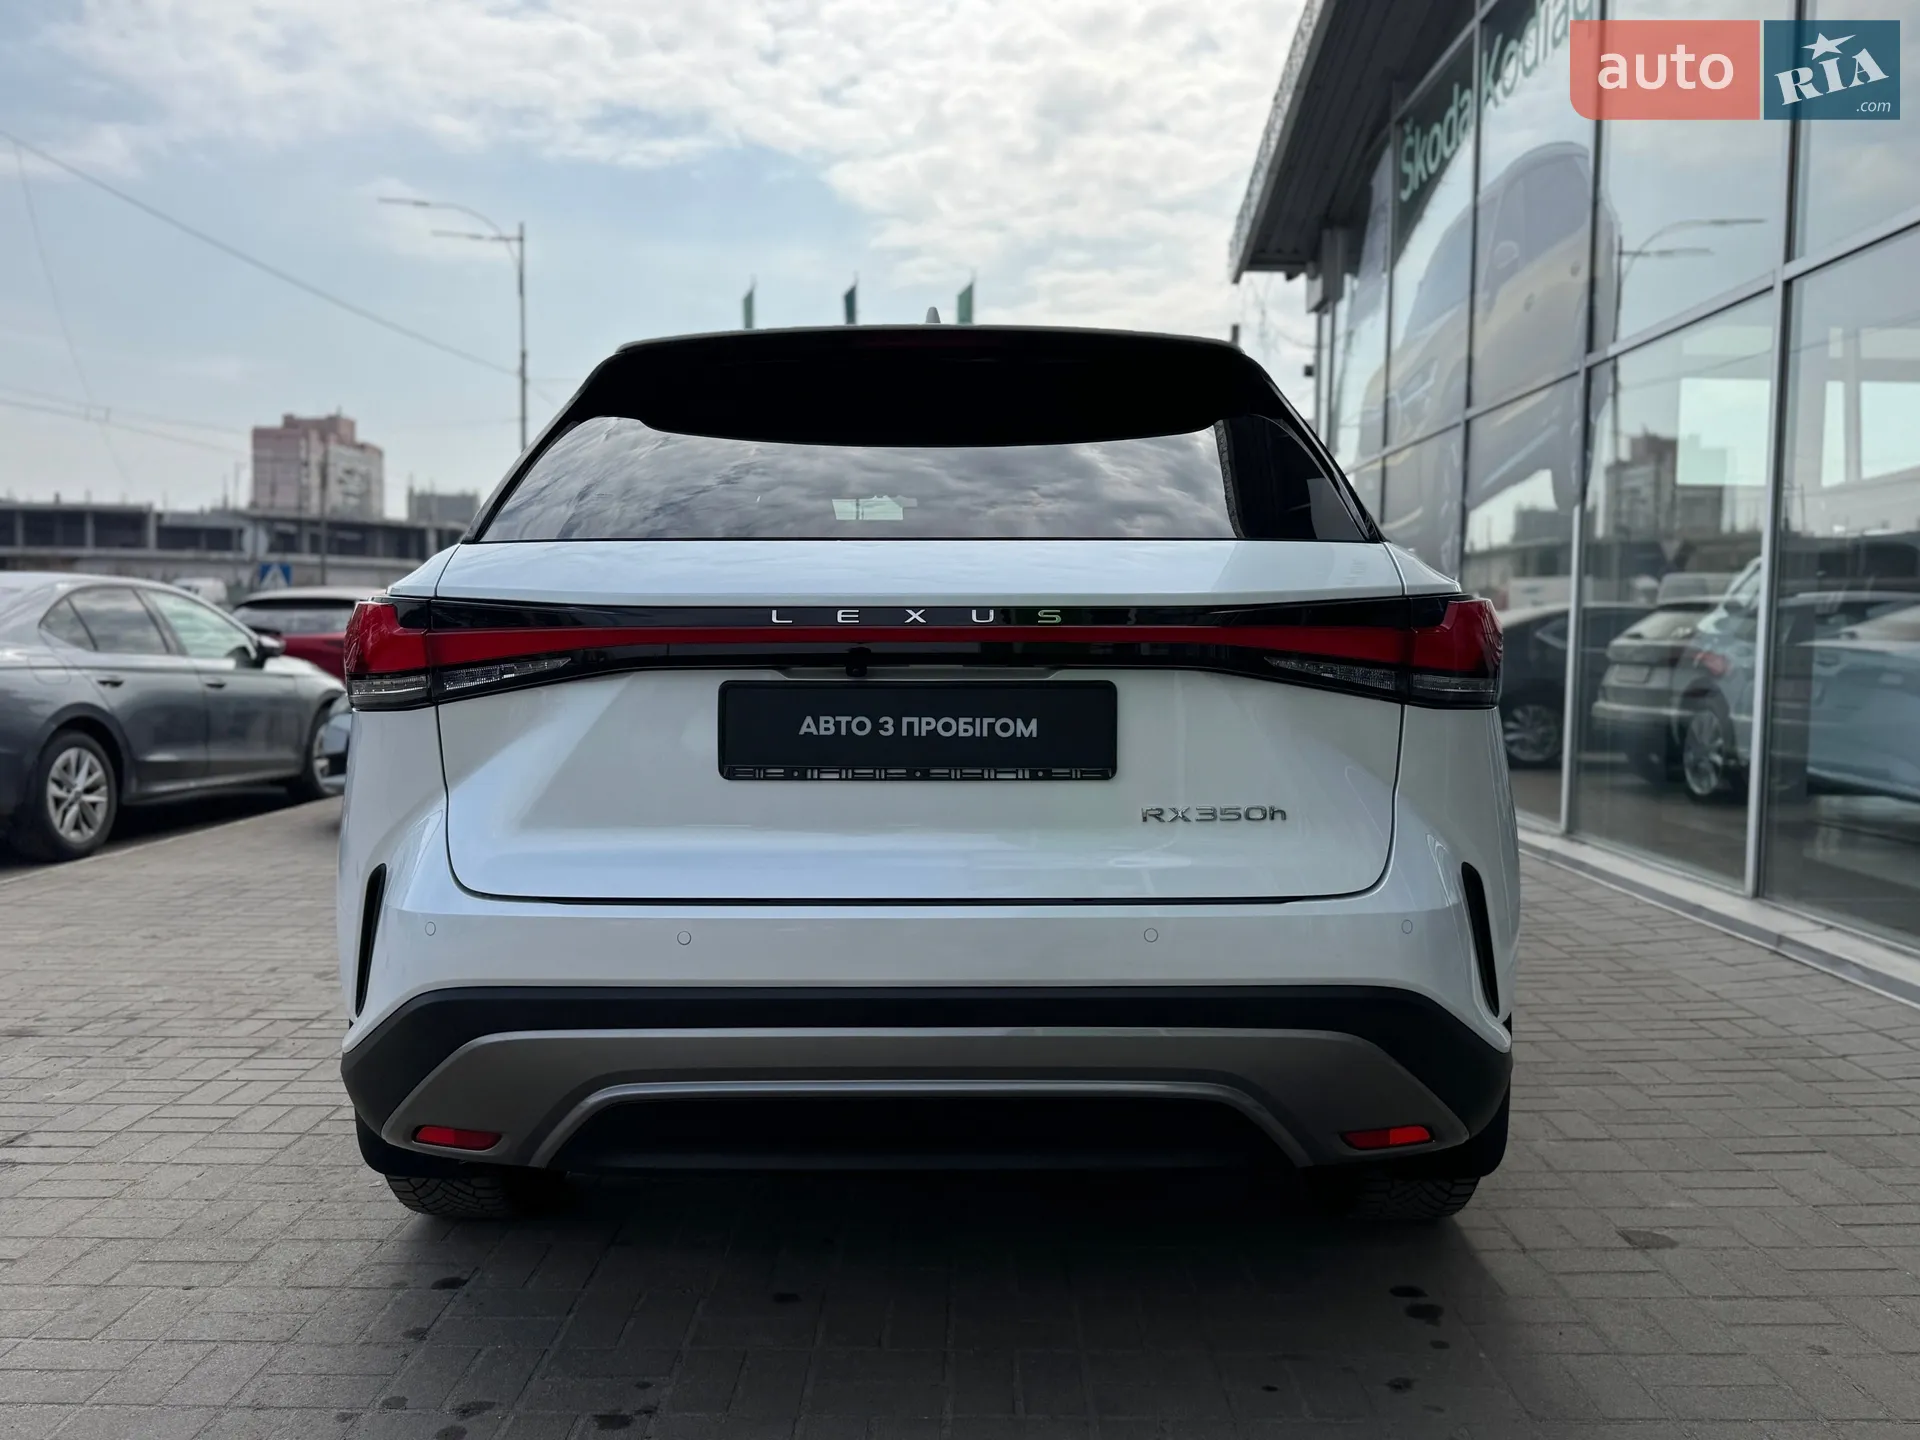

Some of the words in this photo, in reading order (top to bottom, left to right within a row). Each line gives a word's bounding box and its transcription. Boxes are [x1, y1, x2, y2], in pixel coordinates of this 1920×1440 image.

[1400, 83, 1474, 202] Škoda
[771, 608, 1063, 624] LEXUS
[798, 715, 872, 737] АВТО
[878, 716, 895, 738] З
[901, 716, 1038, 738] ПРОБІГОМ
[1141, 804, 1288, 824] RX350h
